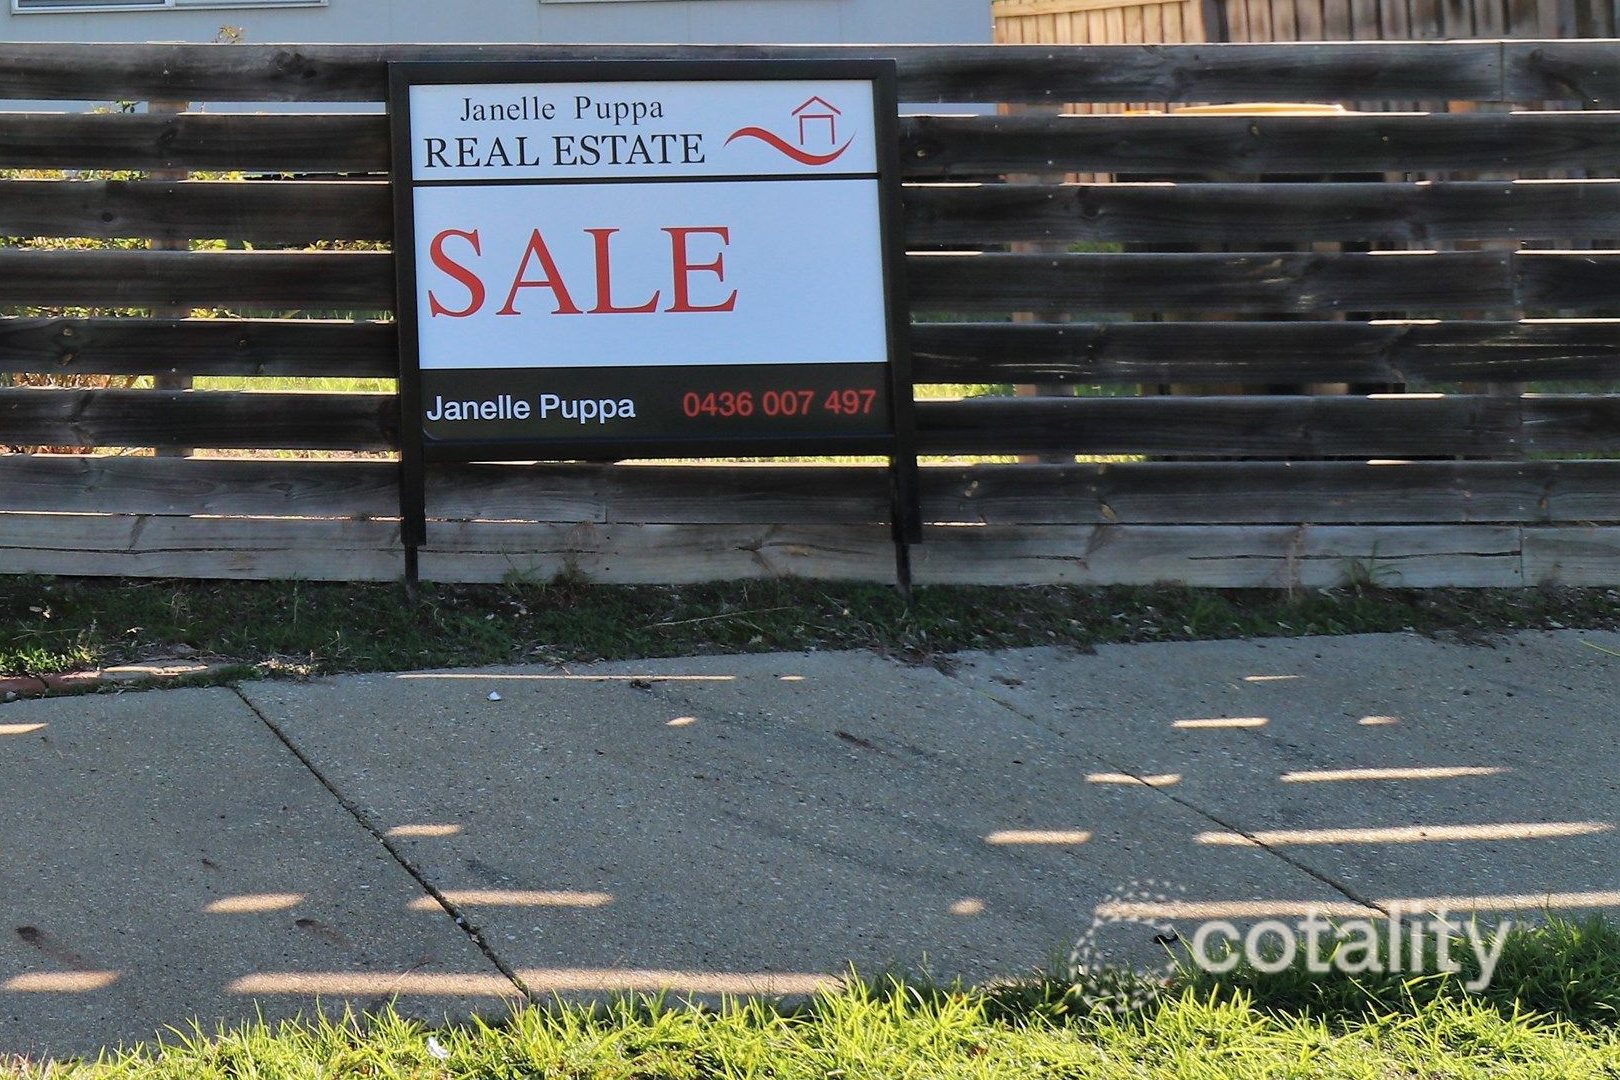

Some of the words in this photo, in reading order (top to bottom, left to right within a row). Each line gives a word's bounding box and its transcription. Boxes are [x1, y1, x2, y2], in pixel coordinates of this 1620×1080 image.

[460, 96, 556, 122] Janelle
[573, 95, 665, 125] Puppa
[424, 136, 540, 169] REAL
[552, 133, 706, 167] ESTATE
[427, 226, 739, 318] SALE
[425, 394, 531, 422] Janelle
[540, 394, 636, 425] Puppa
[683, 392, 754, 418] 0436
[762, 391, 815, 416] 007
[824, 389, 877, 416] 497
